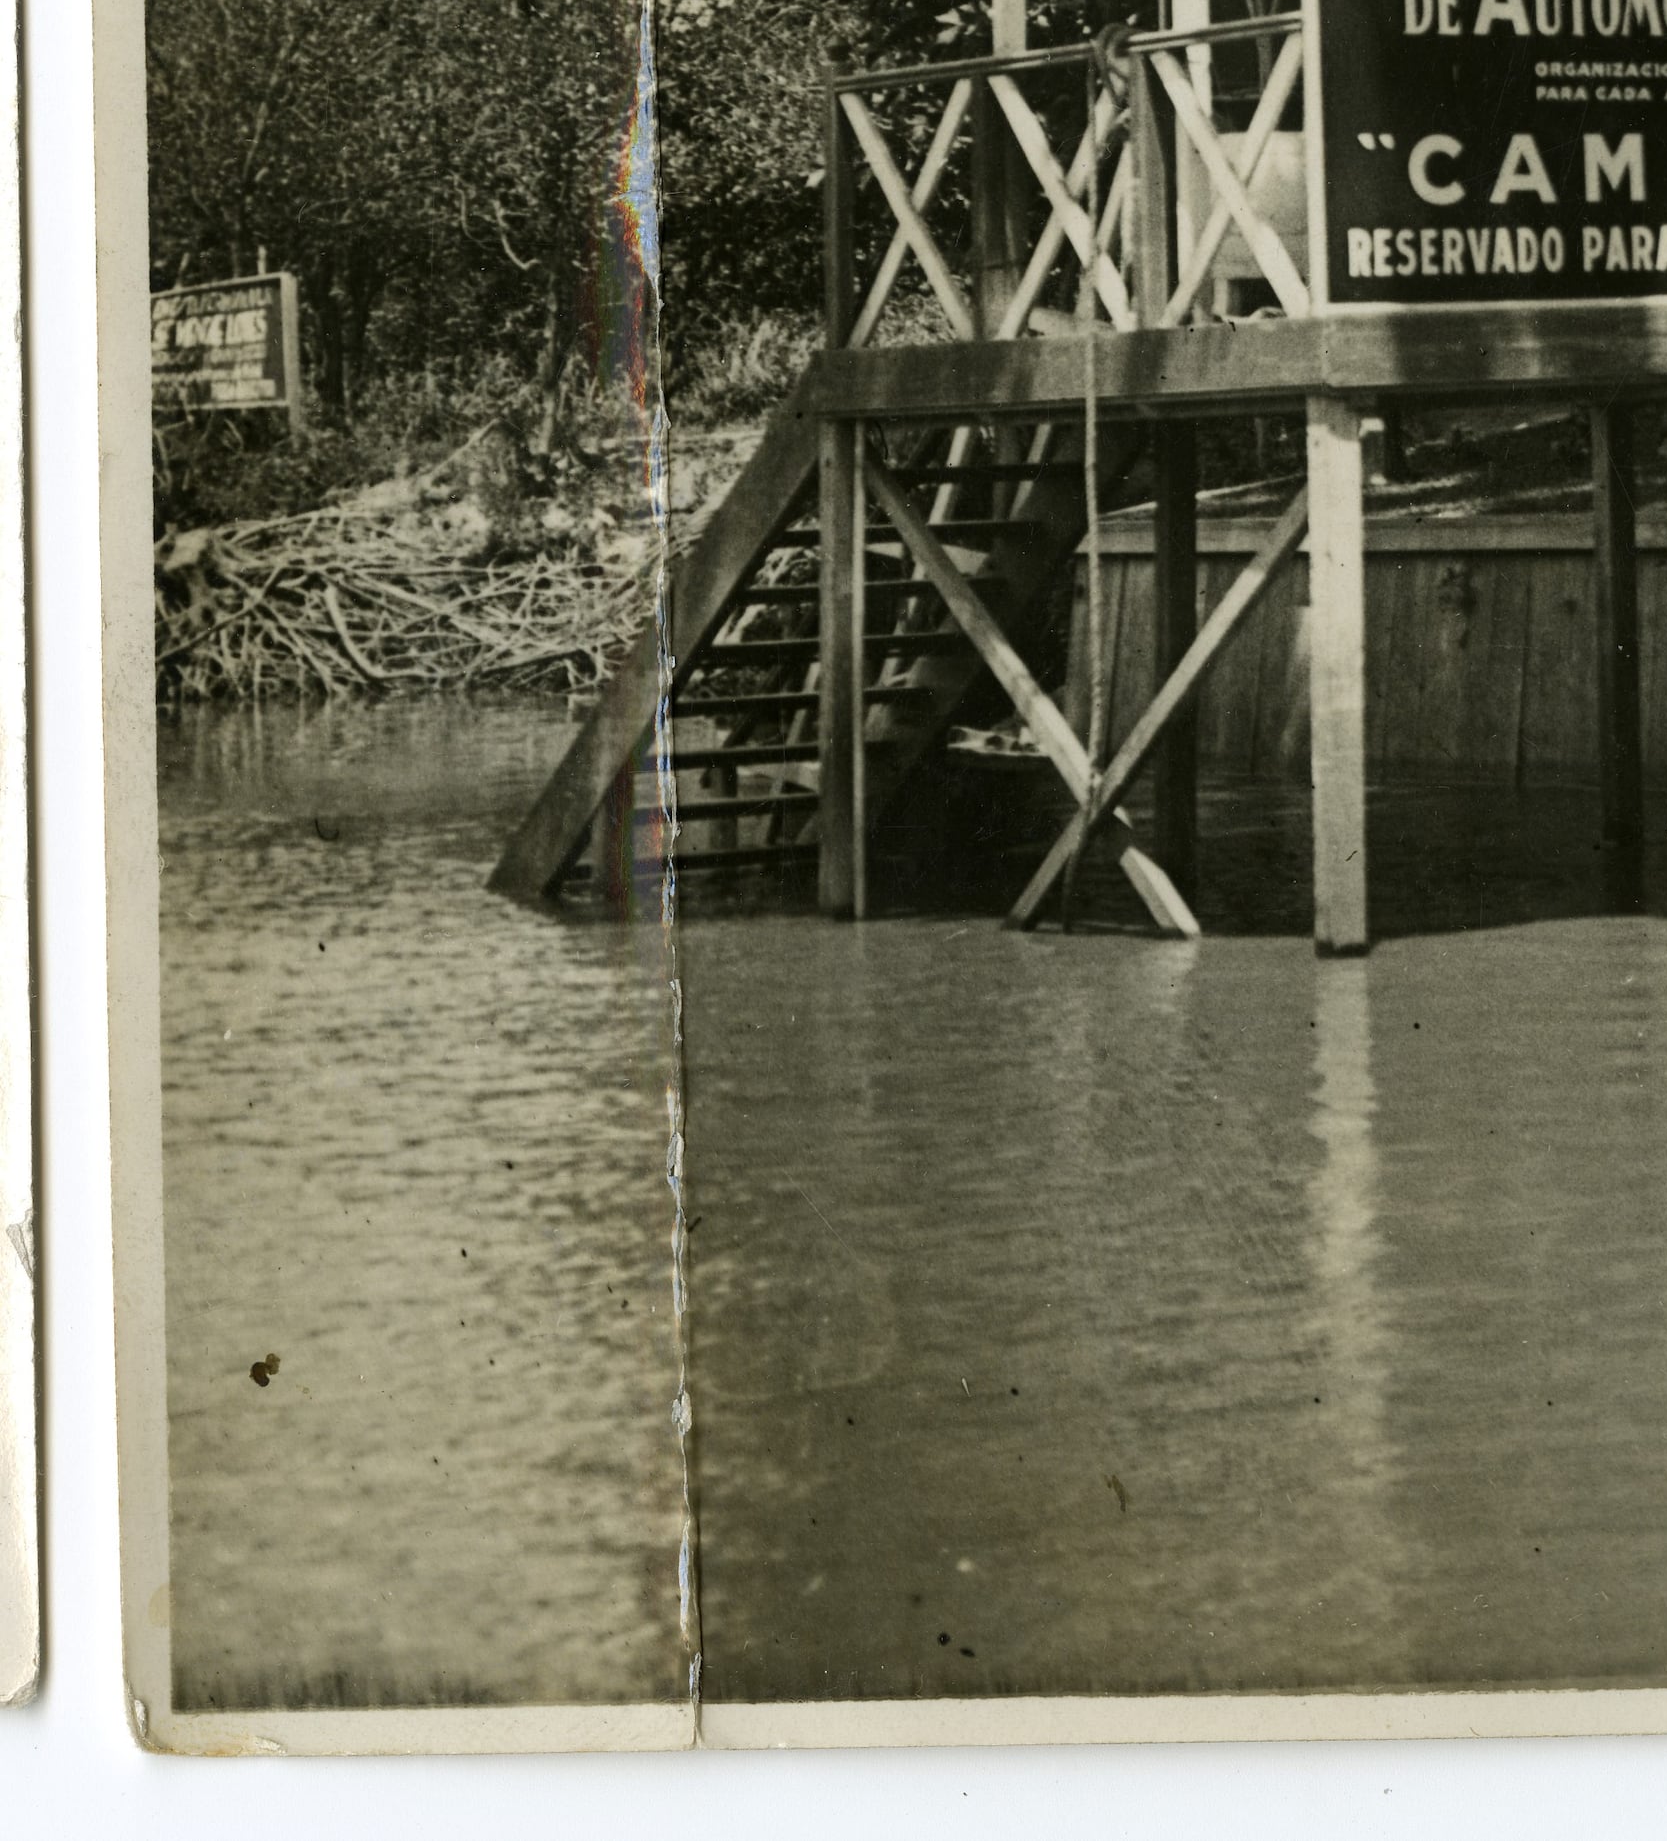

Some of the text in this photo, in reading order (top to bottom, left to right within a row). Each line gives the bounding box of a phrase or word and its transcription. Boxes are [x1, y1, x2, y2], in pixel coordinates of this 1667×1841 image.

[1536, 86, 1587, 101] PARA
[1595, 86, 1651, 101] CADA
[1347, 225, 1564, 277] RESERVADO
